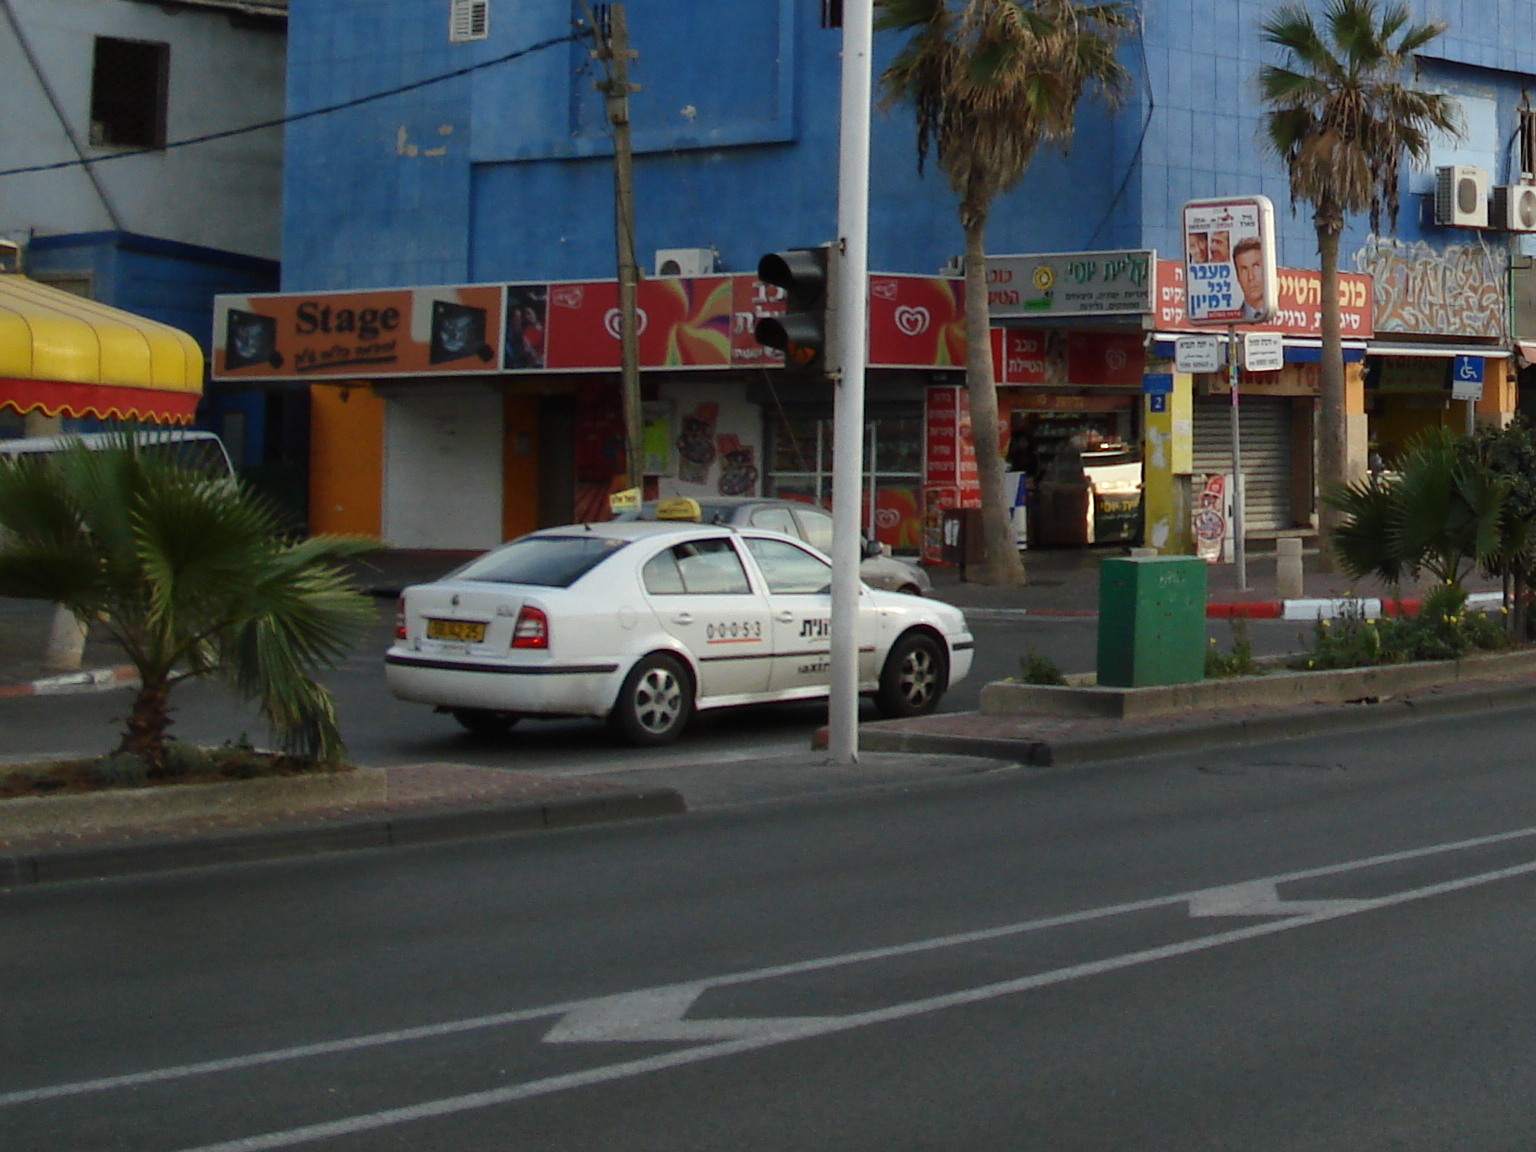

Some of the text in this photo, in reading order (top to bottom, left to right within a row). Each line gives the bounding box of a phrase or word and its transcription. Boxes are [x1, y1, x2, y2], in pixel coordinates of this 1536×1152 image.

[986, 269, 1012, 284] כוכ
[1190, 265, 1231, 280] מעבר
[1208, 281, 1230, 293] לכל
[1339, 279, 1366, 307] כוכ
[1191, 294, 1232, 317] דמיון
[296, 301, 399, 339] Stage
[1155, 396, 1163, 409] 2
[799, 618, 830, 637] ונית
